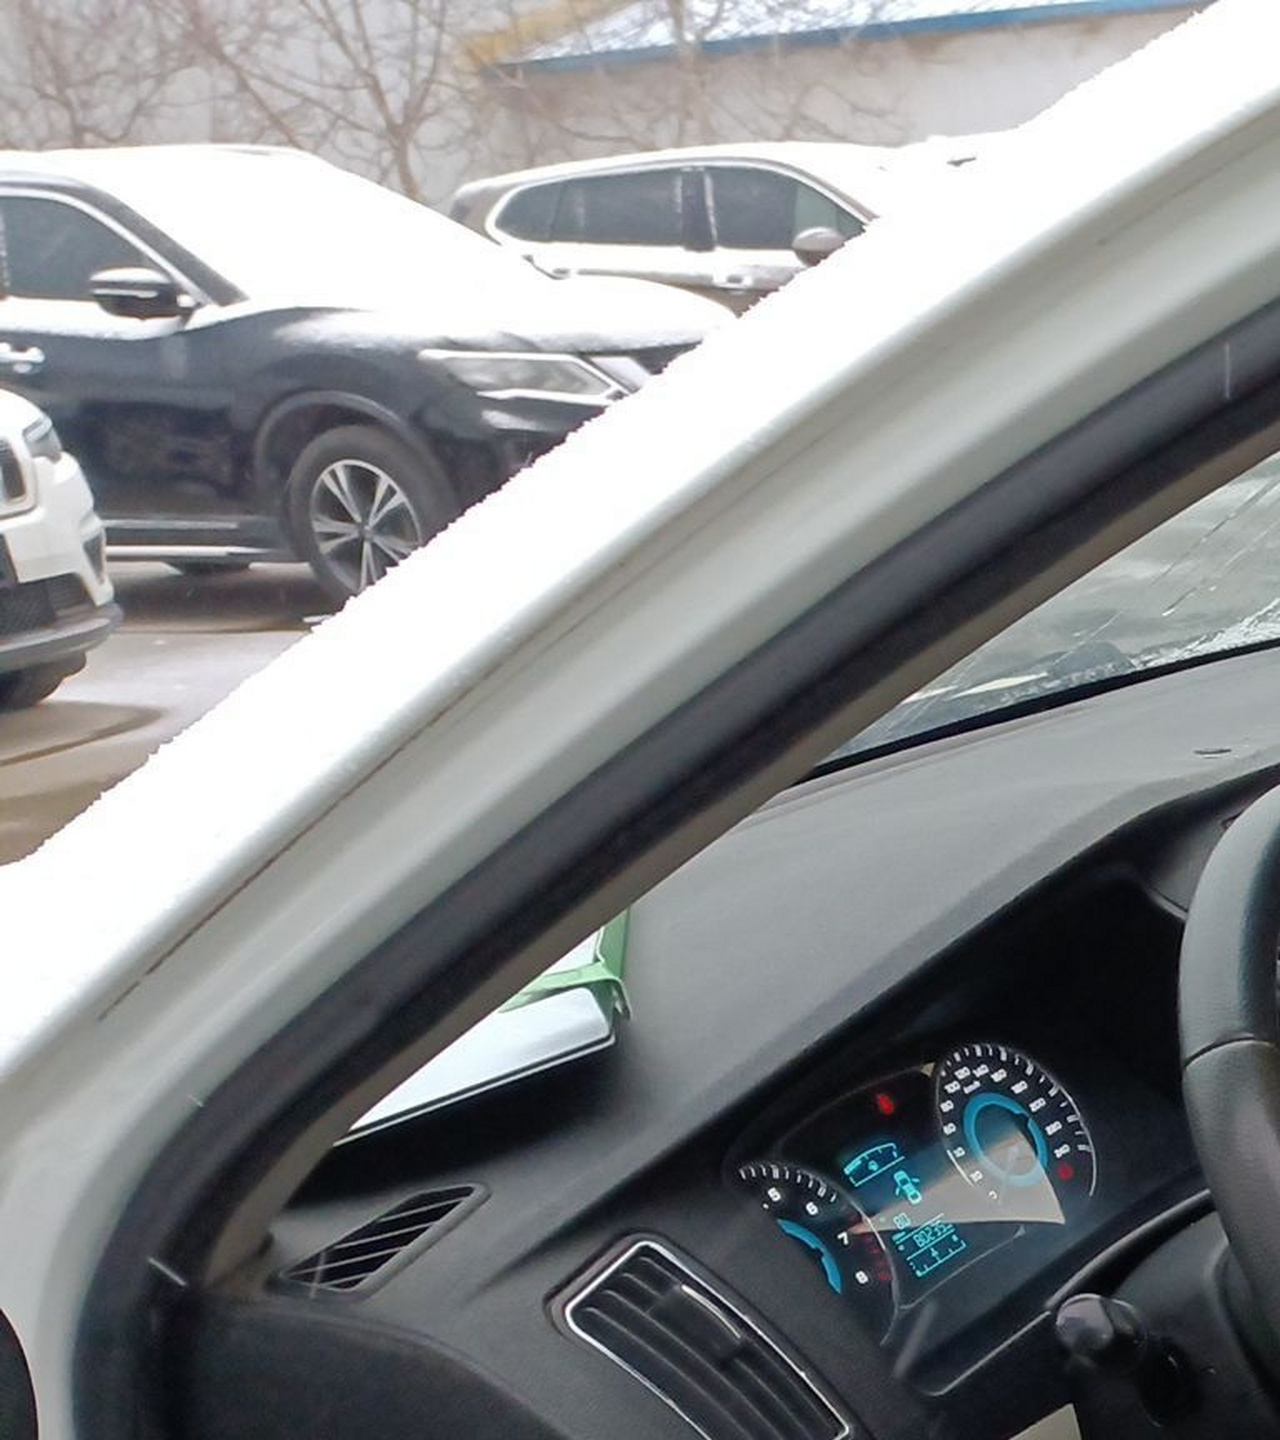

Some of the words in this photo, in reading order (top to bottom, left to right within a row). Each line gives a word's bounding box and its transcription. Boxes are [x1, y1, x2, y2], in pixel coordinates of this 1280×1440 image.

[767, 1187, 781, 1202] 5
[805, 1202, 819, 1215] 6
[837, 1231, 849, 1245] 7
[855, 1270, 869, 1284] 8
